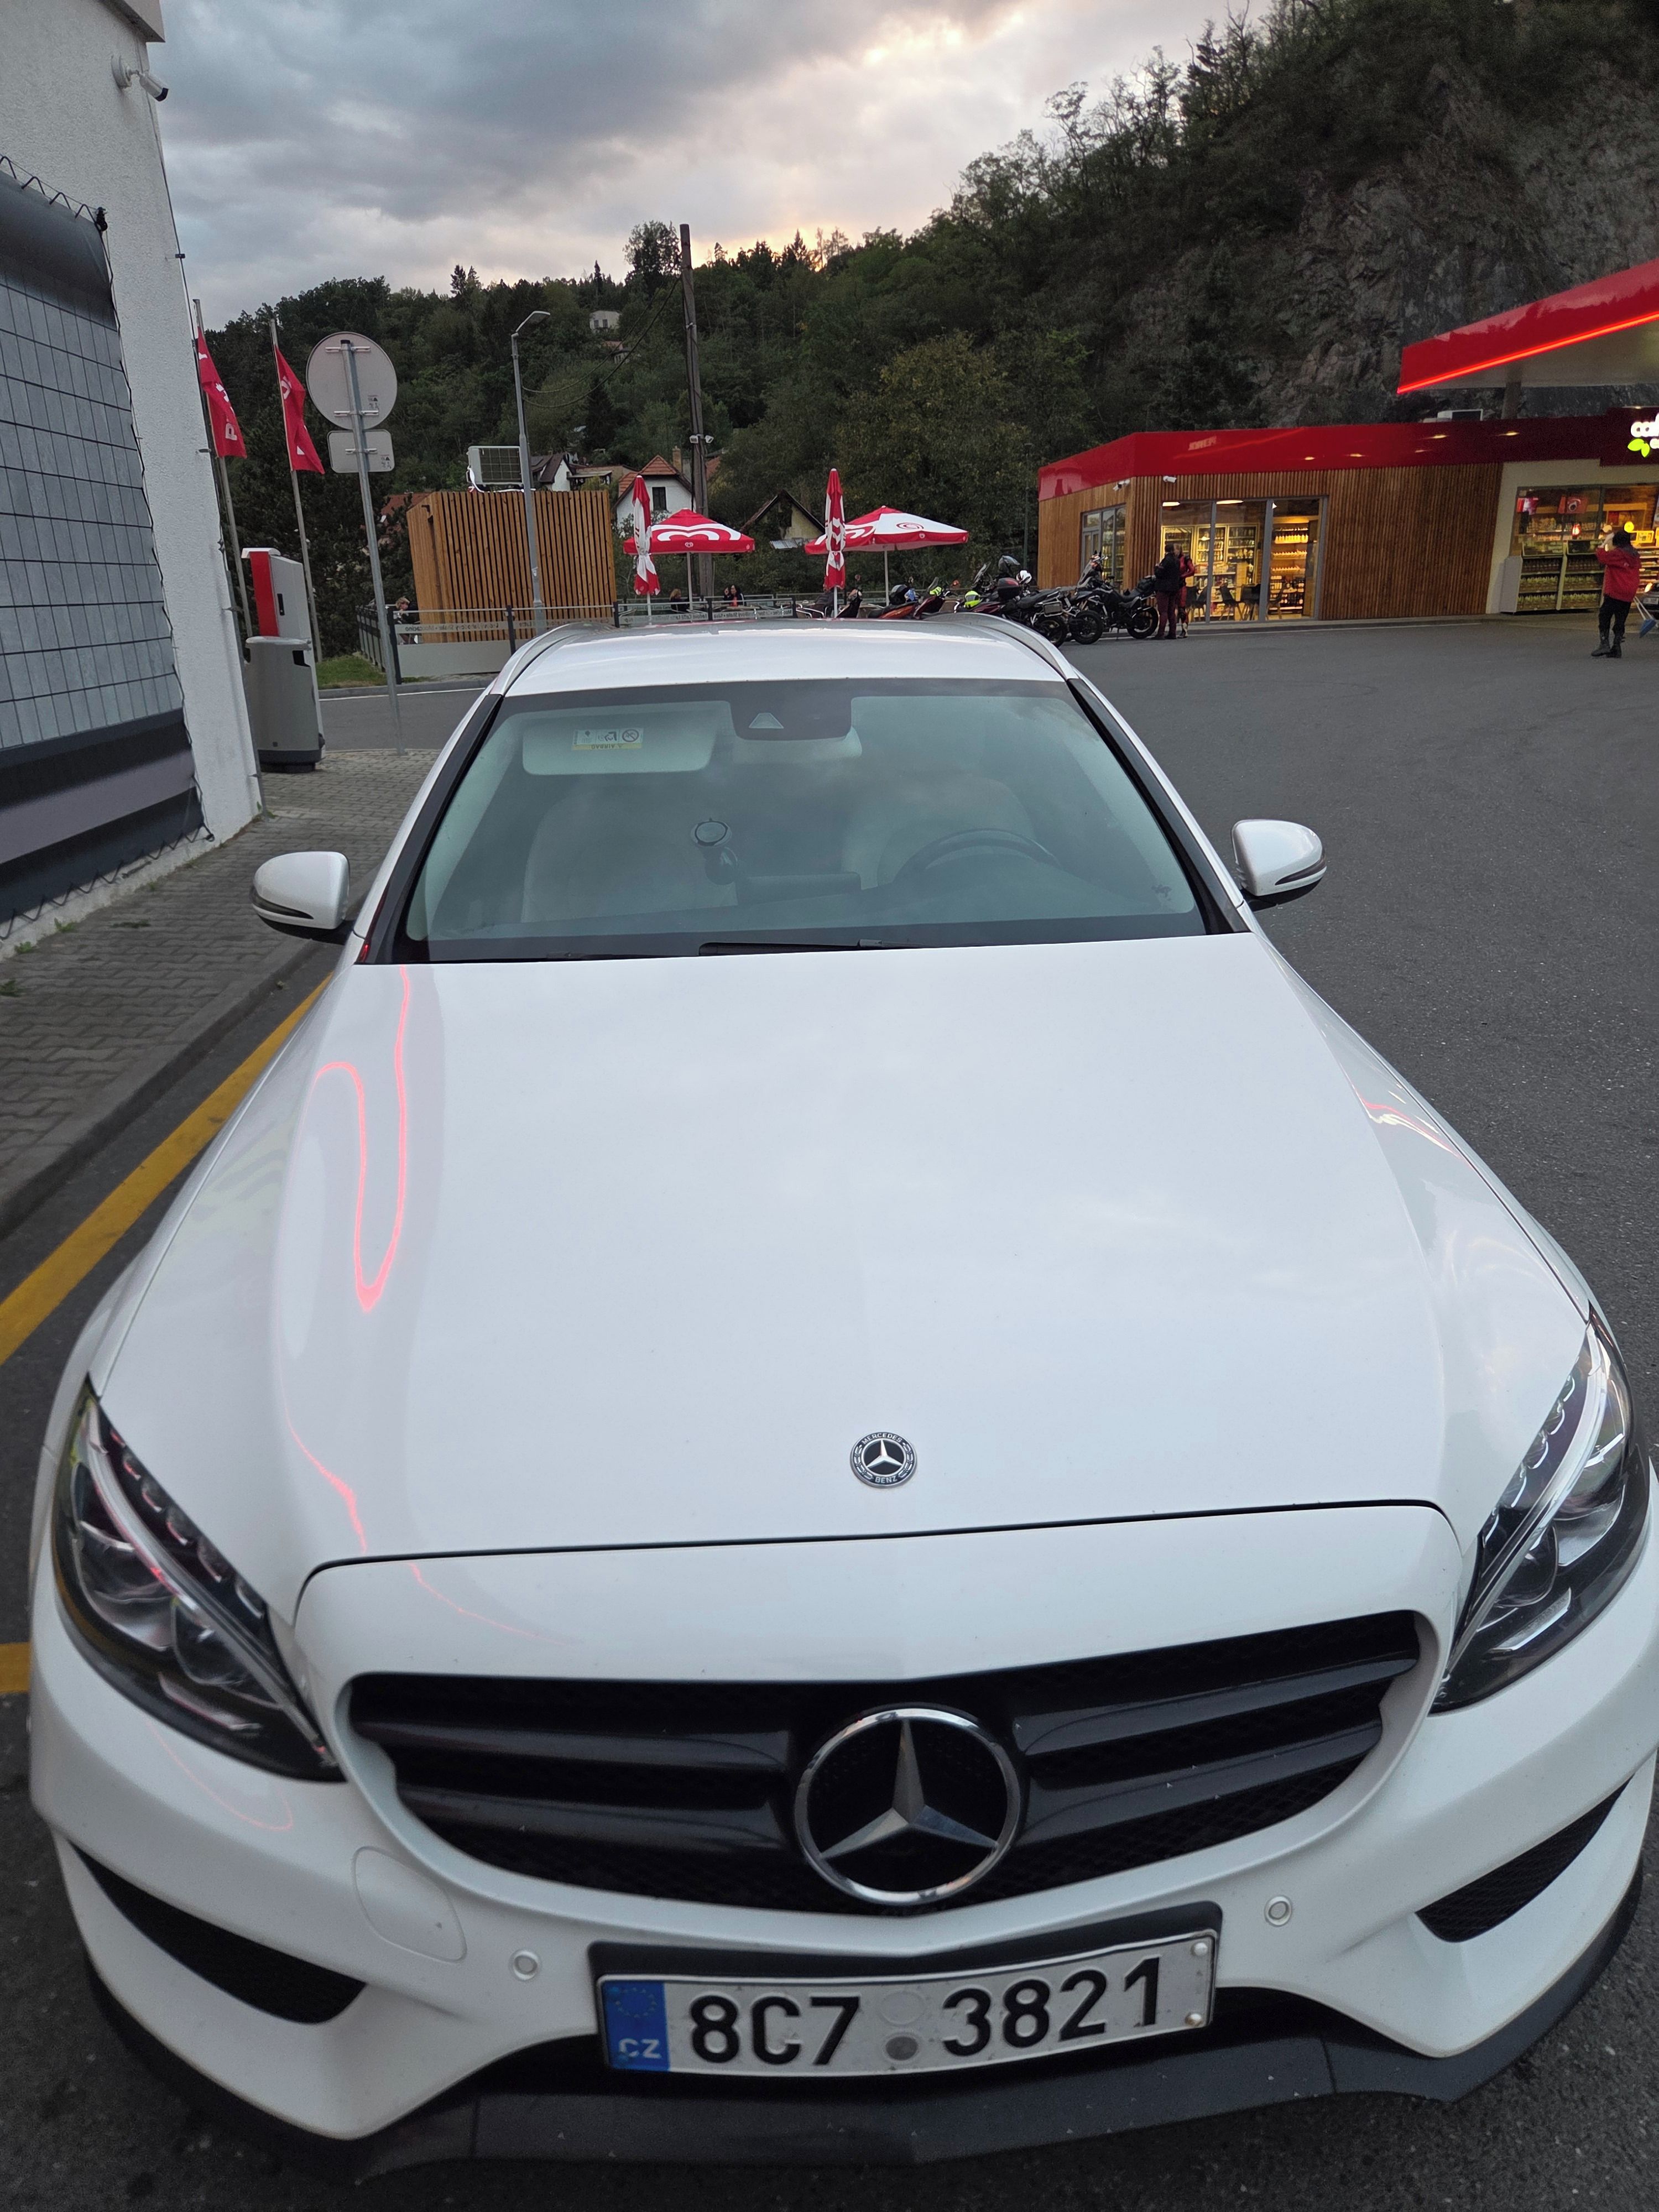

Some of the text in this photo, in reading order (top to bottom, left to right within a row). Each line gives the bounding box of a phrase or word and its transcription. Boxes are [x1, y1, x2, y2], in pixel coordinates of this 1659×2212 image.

[862, 1433, 902, 1444] MERCEDES
[690, 1957, 1161, 2067] 8C7 3821
[619, 2038, 661, 2060] CZ
